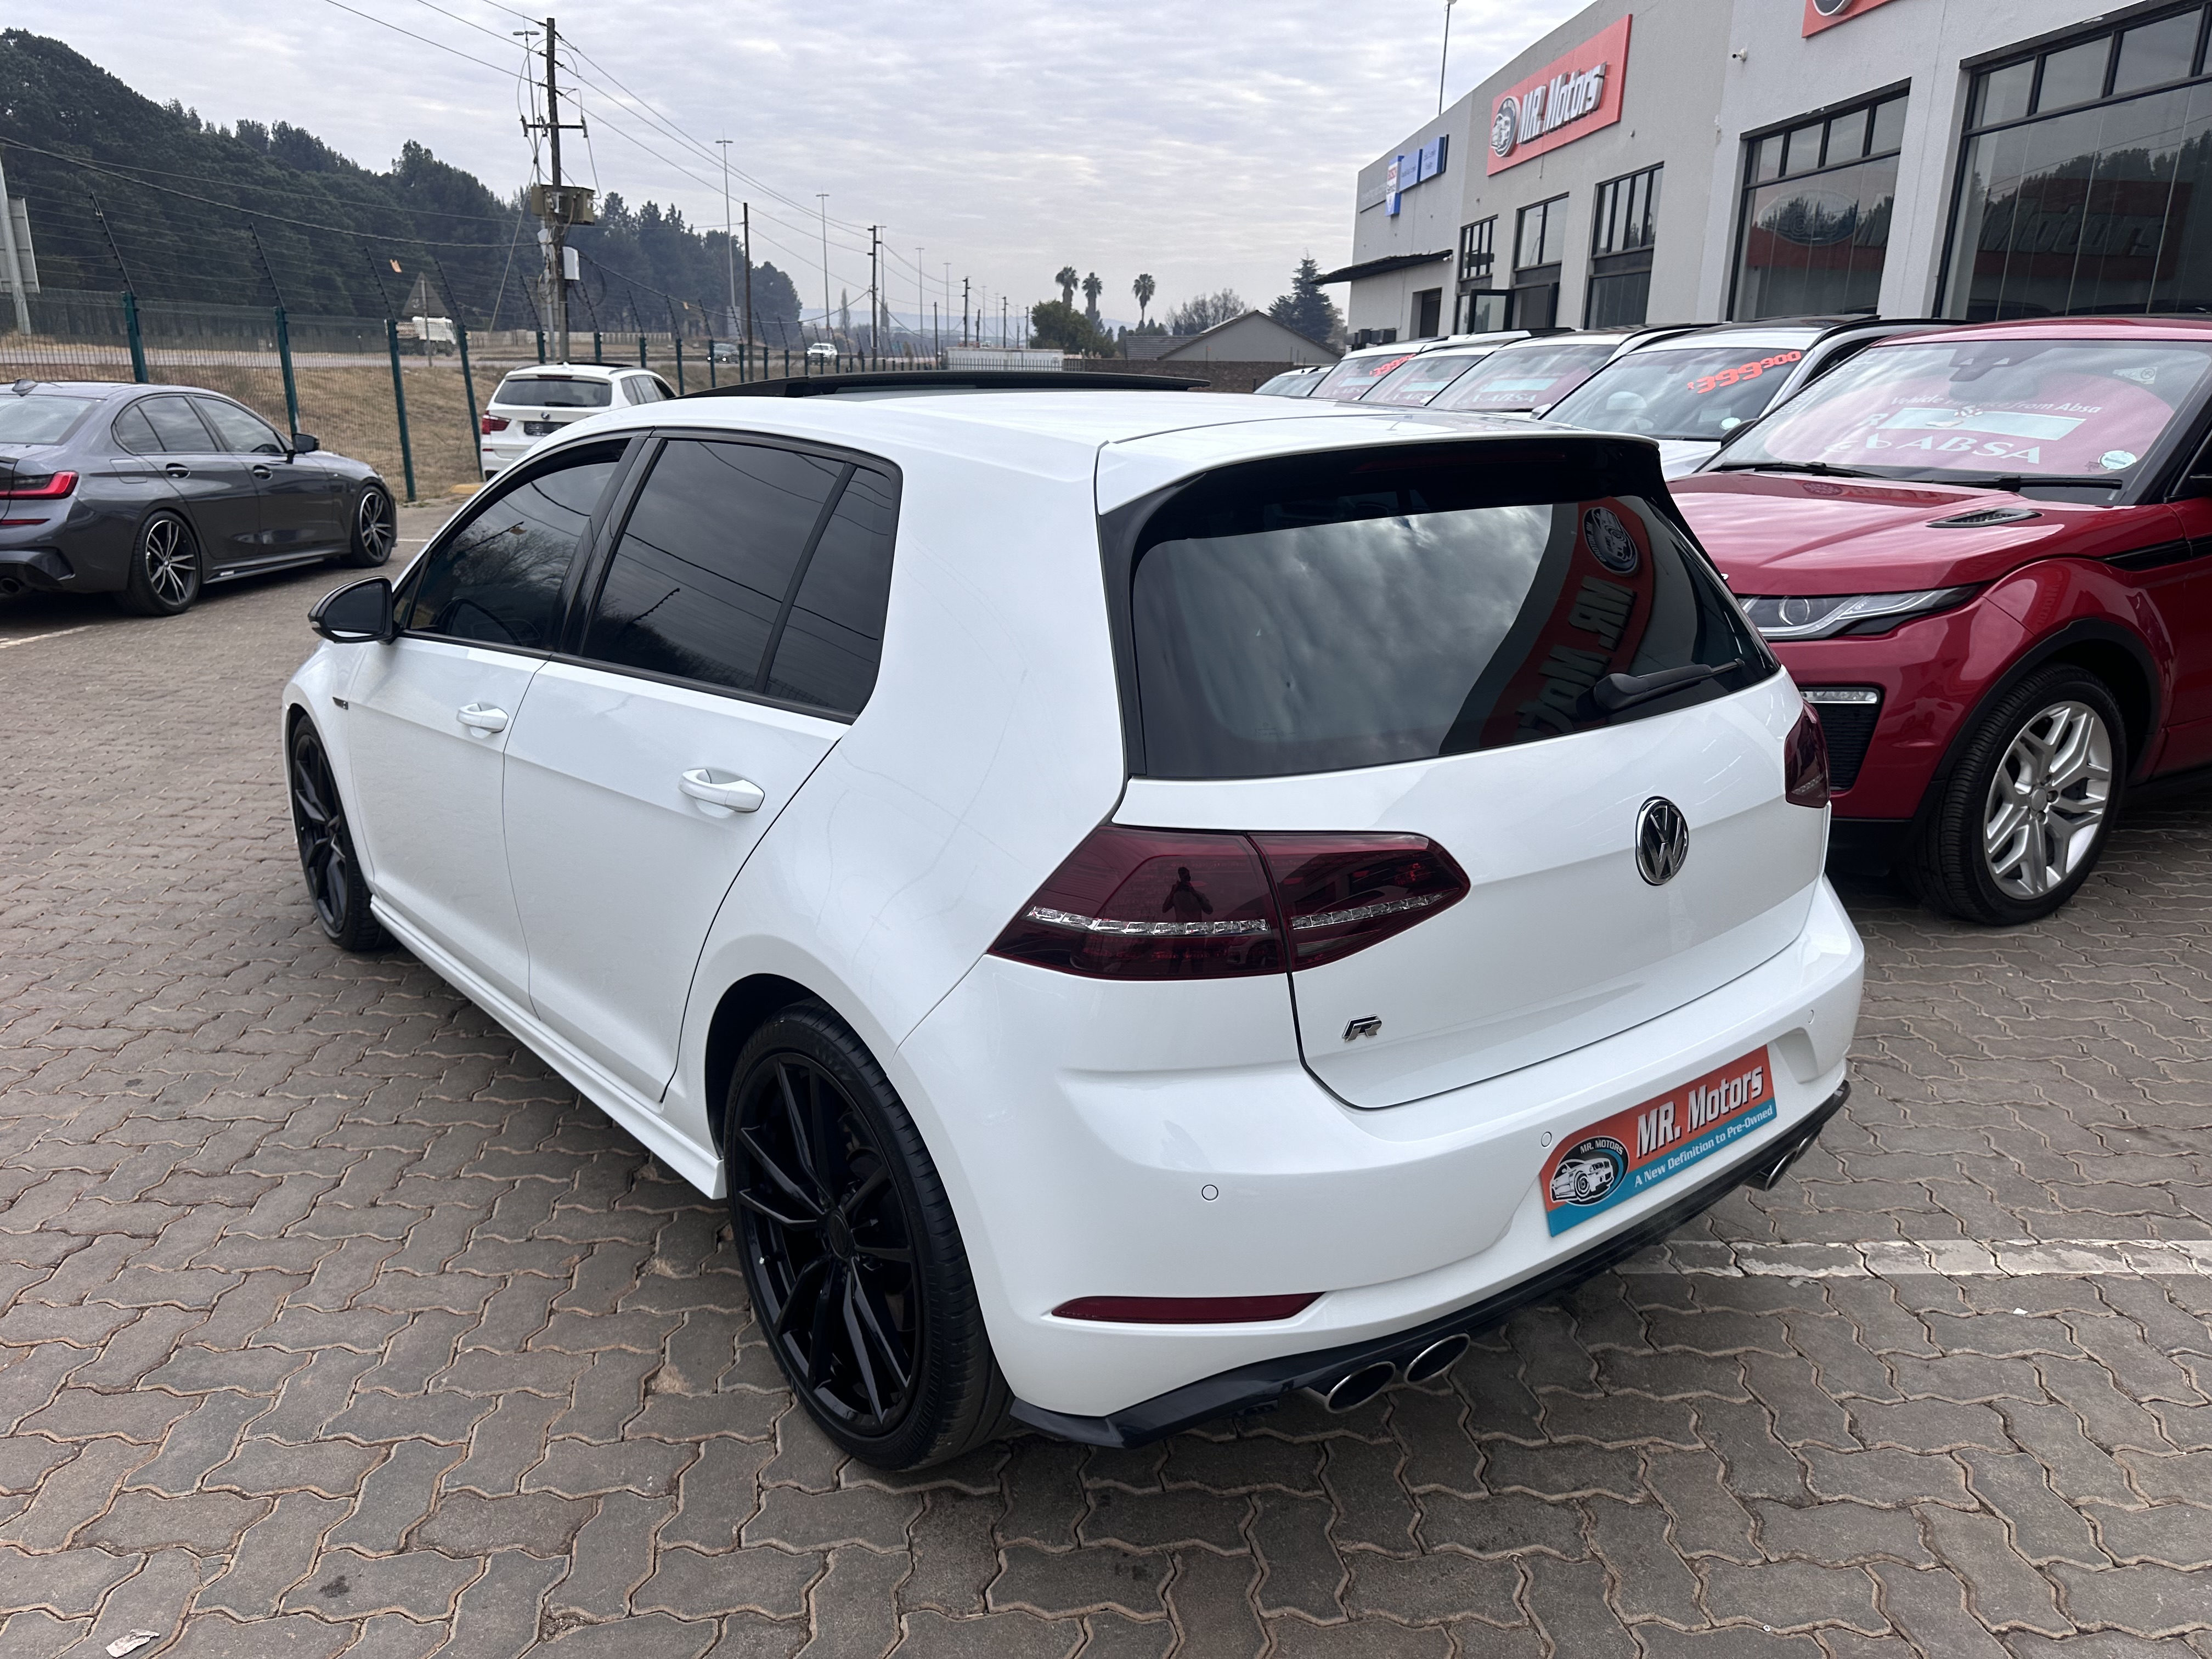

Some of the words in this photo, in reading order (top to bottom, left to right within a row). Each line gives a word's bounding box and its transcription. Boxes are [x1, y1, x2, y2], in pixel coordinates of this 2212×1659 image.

[1516, 84, 1547, 144] MR.
[1542, 61, 1607, 134] Motors
[1891, 395, 1944, 405] Vehicle
[2007, 400, 2053, 410] from
[2054, 402, 2103, 414] Absa
[1342, 1014, 1382, 1042] R
[1636, 1101, 1681, 1159] MR.
[1687, 1066, 1763, 1133] Motors
[1580, 1142, 1594, 1154] MR.
[1595, 1139, 1624, 1155] MOTORS
[1634, 1175, 1643, 1188] A
[1644, 1163, 1666, 1182] New
[1668, 1139, 1714, 1170] Definition
[1716, 1132, 1726, 1144] to
[1727, 1105, 1773, 1138] Pre-Owned
